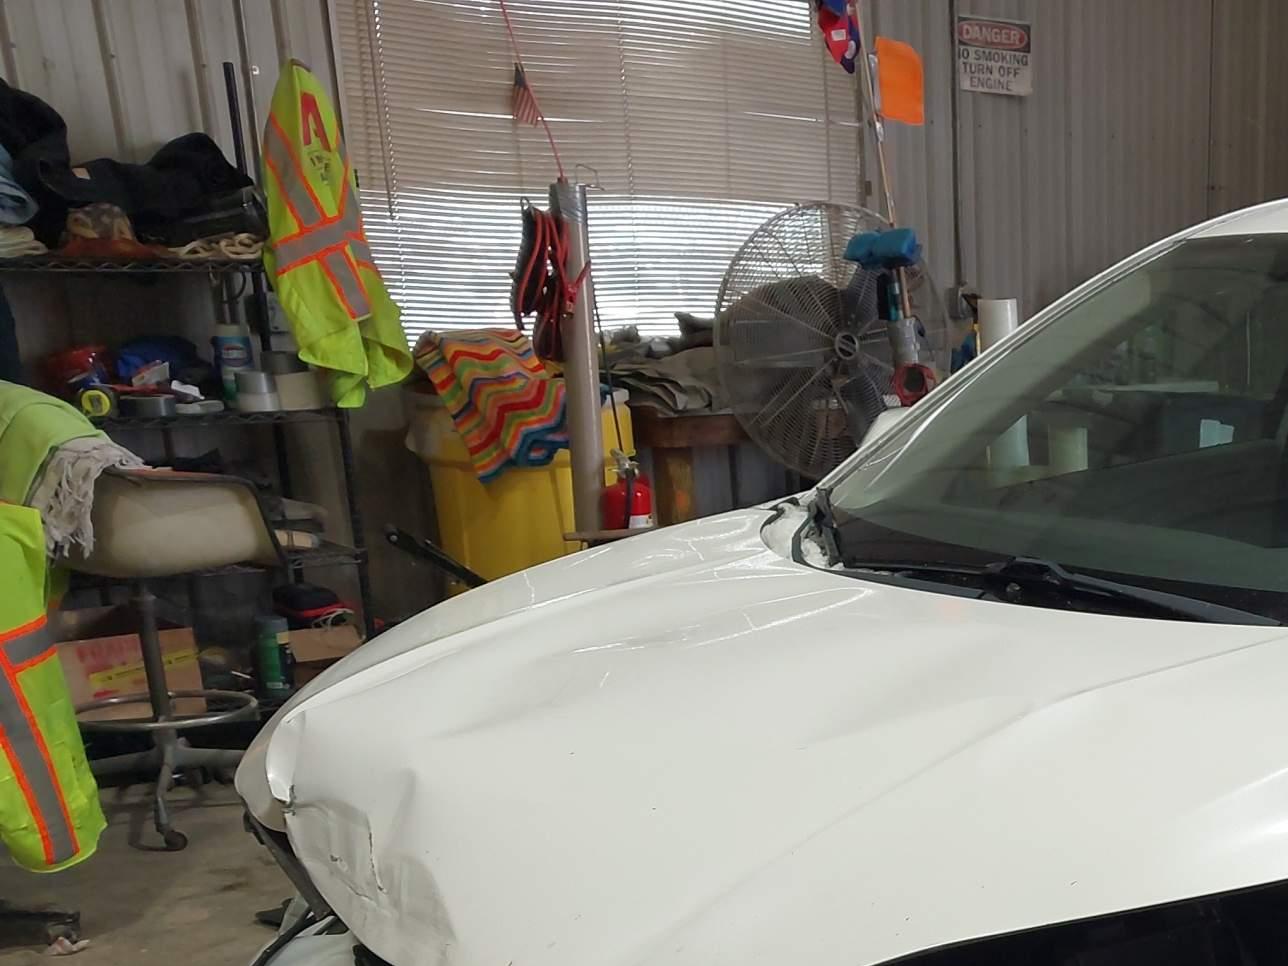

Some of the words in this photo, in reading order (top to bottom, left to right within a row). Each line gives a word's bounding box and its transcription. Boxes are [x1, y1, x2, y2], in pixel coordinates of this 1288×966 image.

[962, 24, 1020, 45] DANGER
[974, 49, 1029, 66] SMOKING
[962, 62, 993, 75] TURN
[998, 65, 1020, 78] OFF
[970, 76, 1013, 91] ENGINE
